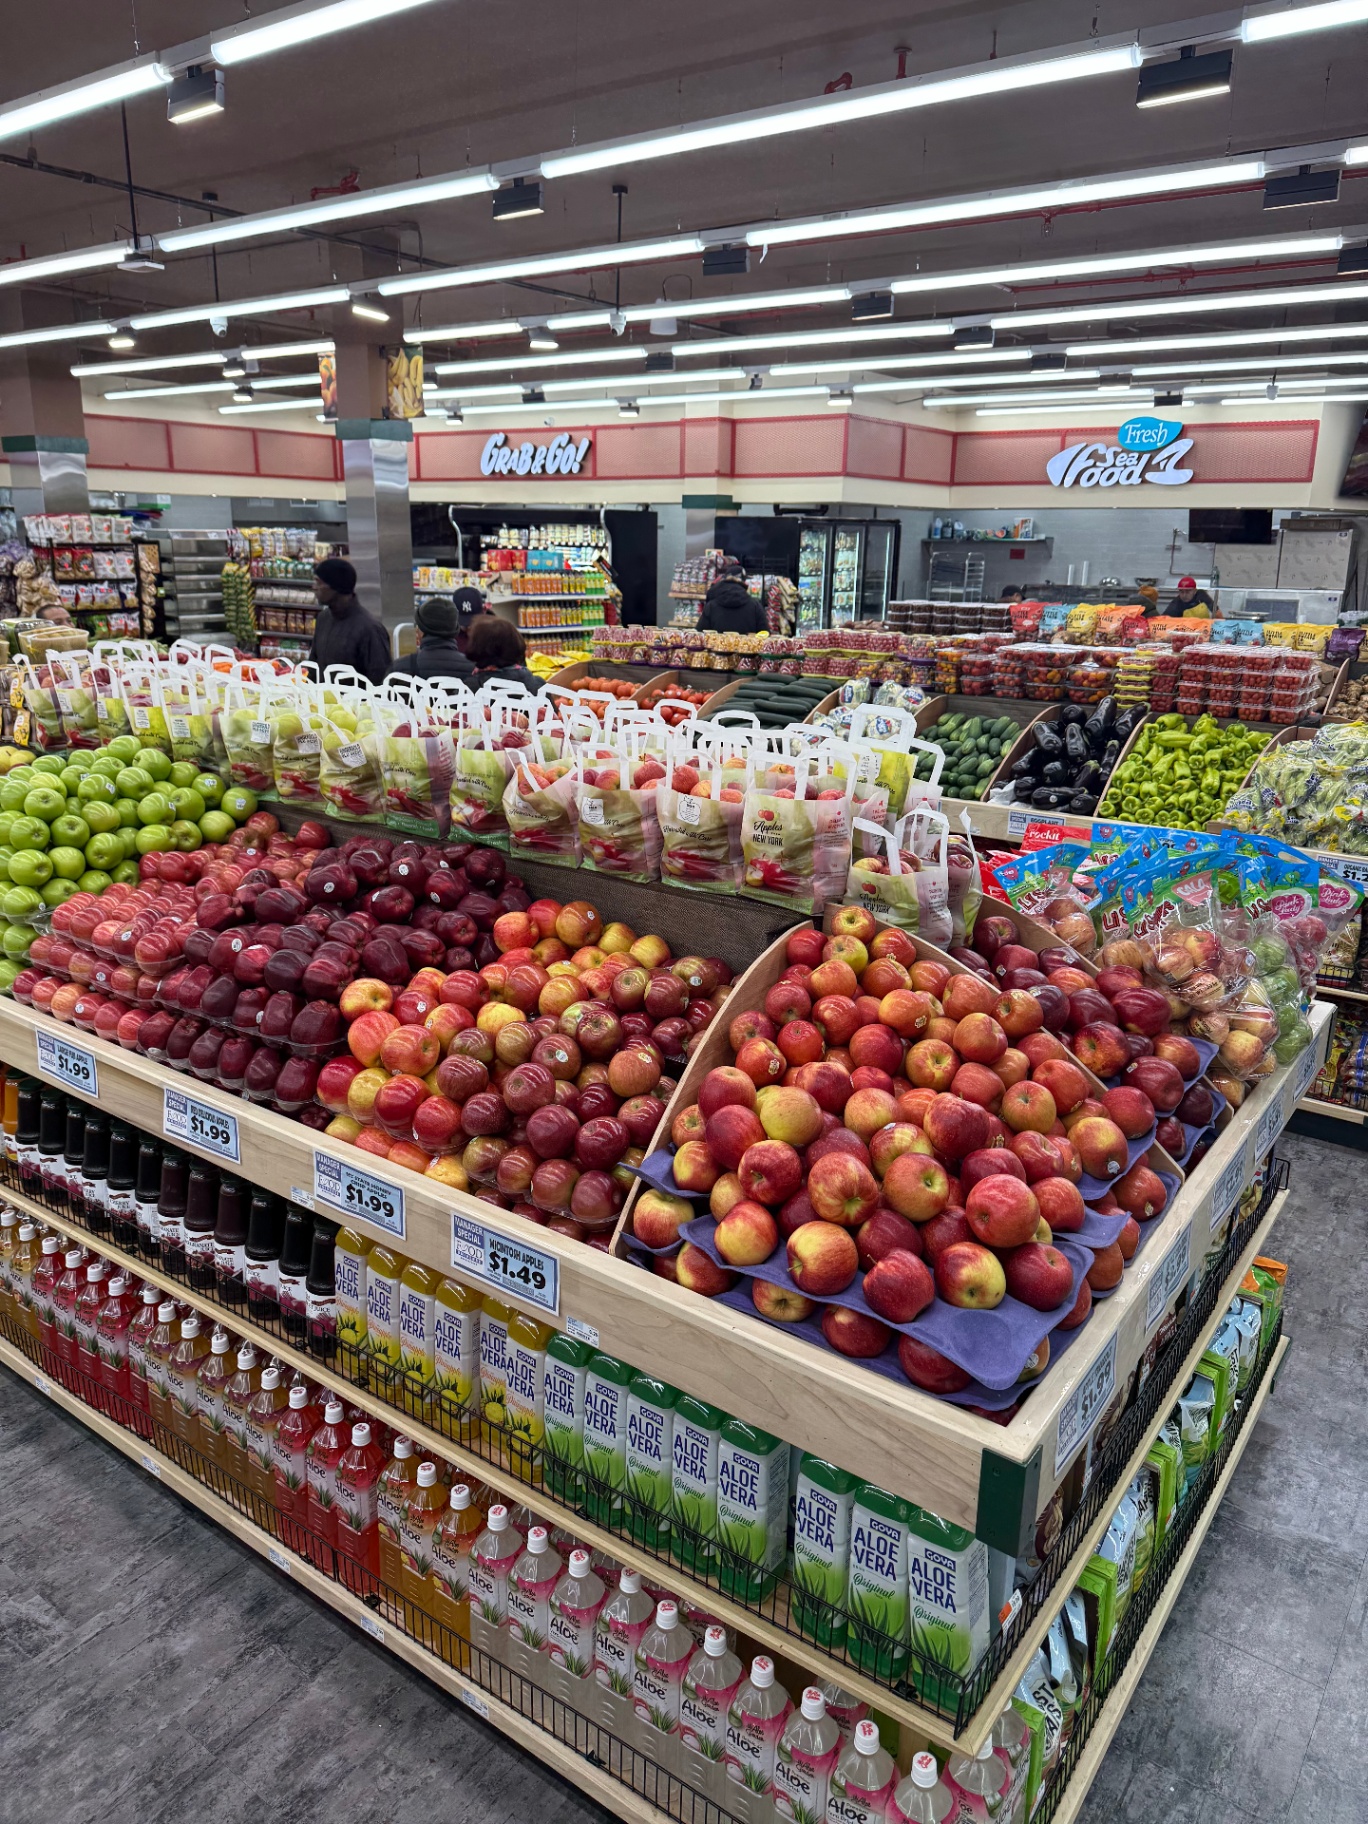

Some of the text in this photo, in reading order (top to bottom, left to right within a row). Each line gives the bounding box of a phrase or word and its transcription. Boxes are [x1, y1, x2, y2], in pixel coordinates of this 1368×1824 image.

[1125, 422, 1168, 447] Fresh
[1096, 445, 1139, 467] Sea
[752, 834, 783, 846] NEW YORK
[753, 821, 783, 834] Apples
[1029, 829, 1059, 841] rockit
[1321, 887, 1348, 899] Pink
[58, 1055, 90, 1080] $1.99
[168, 1099, 186, 1113] SPECIAL
[191, 1115, 231, 1145] $1.99
[316, 1153, 340, 1170] MANAGER
[318, 1163, 339, 1179] SPECIAL
[346, 1183, 395, 1218] $1.99
[454, 1216, 483, 1237] MANAGER
[457, 1228, 481, 1246] SPECIAL
[489, 1250, 546, 1290] $1.49
[521, 1252, 544, 1271] APPLES
[336, 1263, 359, 1287] ALOE
[336, 1277, 359, 1302] VERA
[367, 1285, 391, 1311] ALOE
[368, 1299, 391, 1326] VERA
[401, 1301, 425, 1326] ALOE
[400, 1315, 425, 1342] VERA
[435, 1319, 462, 1346] ALOE
[435, 1333, 461, 1361] VERA
[481, 1331, 507, 1356] ALOE
[481, 1346, 507, 1373] VERA
[507, 1356, 536, 1386] ALOE
[507, 1371, 535, 1402] VERA
[554, 1365, 575, 1383] GOYA
[545, 1373, 575, 1403] ALOE
[596, 1384, 619, 1402] GOYA
[1081, 1359, 1112, 1422] $1.99
[545, 1389, 575, 1420] VERA
[585, 1391, 618, 1422] ALOE
[640, 1407, 663, 1425] GOYA
[545, 1412, 574, 1434] Original
[585, 1407, 617, 1440] VERA
[629, 1414, 663, 1446] ALOE
[584, 1434, 616, 1456] Original
[628, 1430, 662, 1462] VERA
[686, 1427, 709, 1446] GOYA
[273, 1444, 292, 1462] Aloe
[674, 1434, 708, 1467] ALOE
[733, 1453, 759, 1473] GOYA
[305, 1456, 326, 1478] Aloe
[628, 1455, 661, 1478] Original
[674, 1450, 707, 1485] VERA
[720, 1460, 759, 1494] ALOE
[335, 1482, 356, 1501] Aloe
[674, 1477, 706, 1500] Original
[720, 1477, 757, 1511] VERA
[811, 1490, 837, 1513] GOYA
[377, 1493, 400, 1515] Aloe
[720, 1504, 756, 1529] Original
[798, 1496, 836, 1534] ALOE
[400, 1521, 421, 1544] Aloe
[797, 1513, 834, 1553] VERA
[871, 1519, 900, 1541] GOYA
[432, 1544, 456, 1569] Aloe
[796, 1541, 833, 1571] Original
[854, 1527, 899, 1563] ALOE
[854, 1544, 897, 1582] VERA
[926, 1549, 956, 1571] GOYA
[469, 1568, 493, 1594] Aloe
[853, 1572, 896, 1600] Original
[912, 1557, 957, 1594] ALOE
[508, 1592, 534, 1617] Aloe
[912, 1576, 957, 1613] VERA
[550, 1617, 579, 1645] Aloe
[913, 1605, 957, 1632] Original
[597, 1633, 626, 1661] Aloe
[634, 1671, 666, 1700] Aloe
[682, 1699, 716, 1729] Aloe
[726, 1727, 761, 1758] Aloe
[775, 1762, 811, 1795] Aloe
[828, 1797, 868, 1824] Aloe
